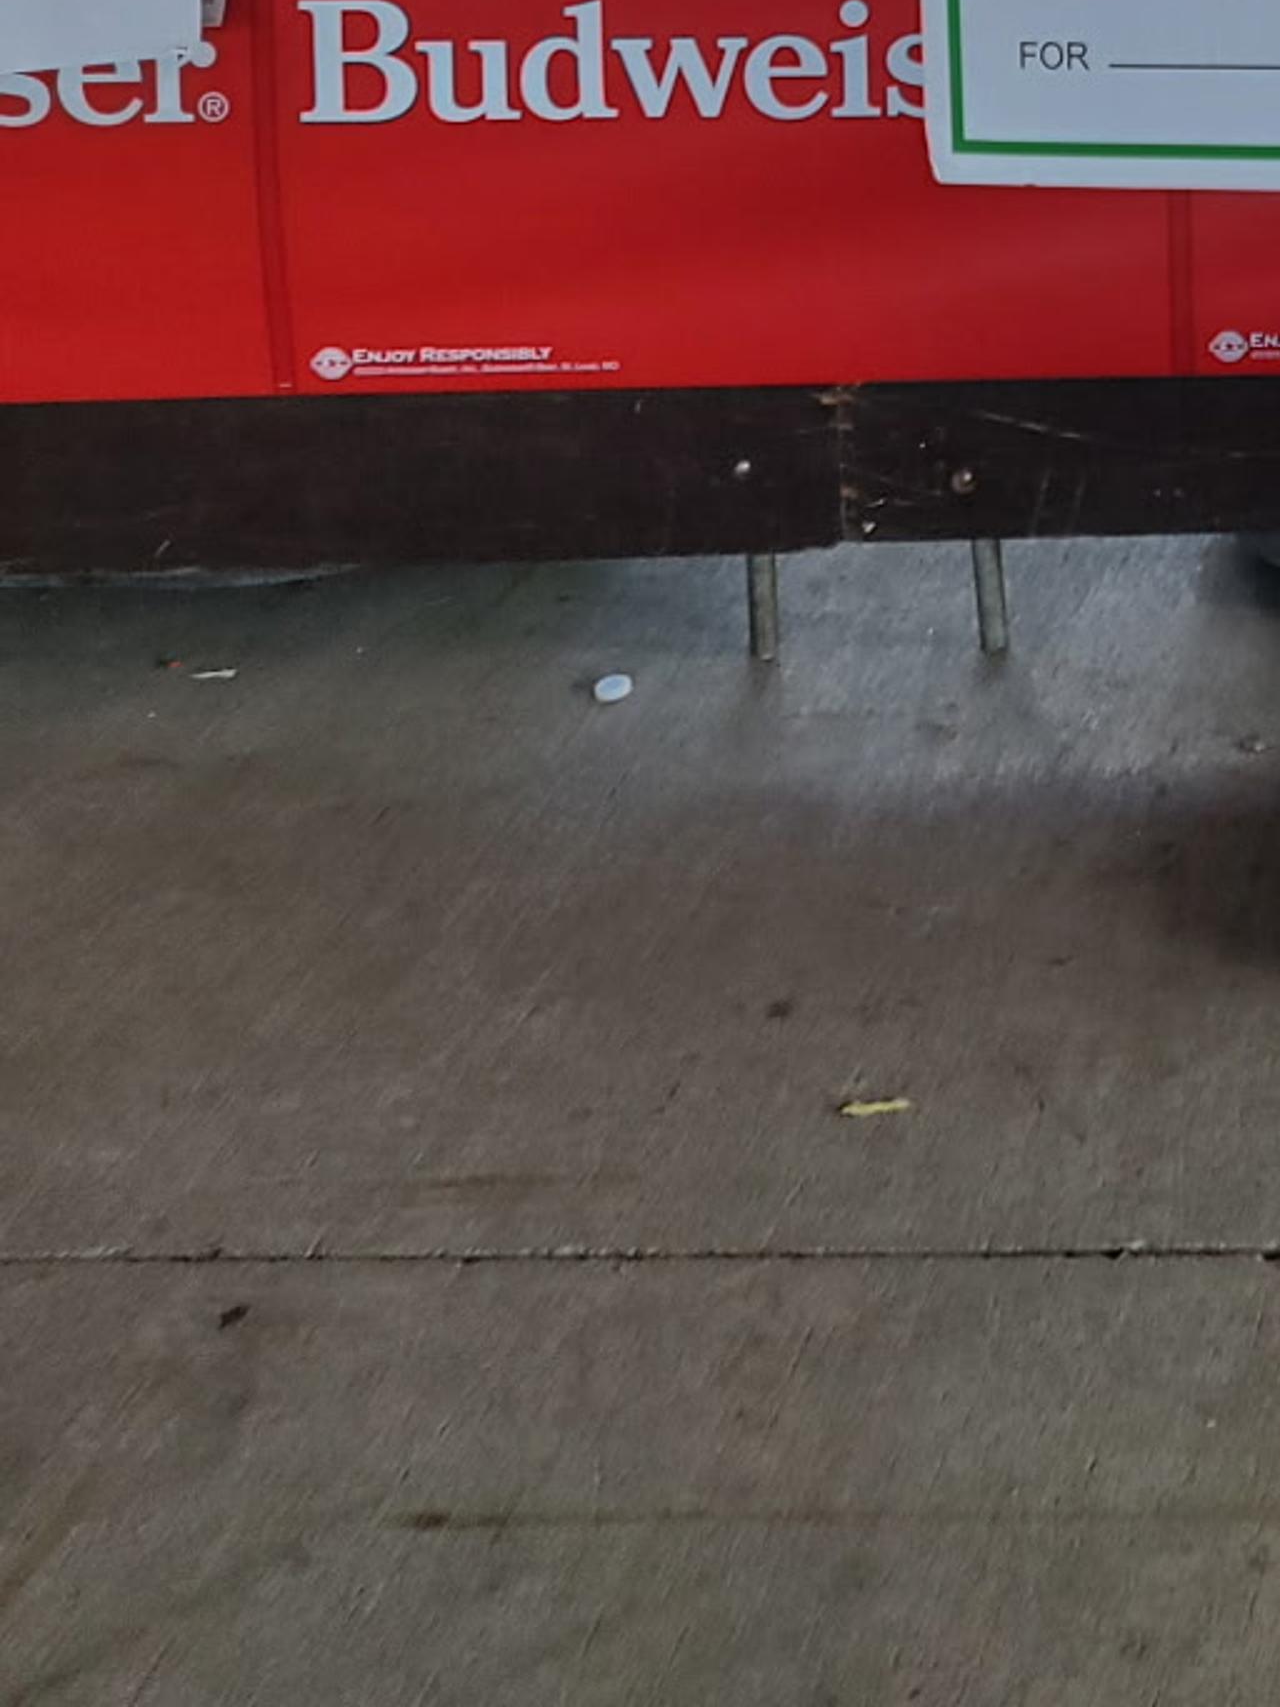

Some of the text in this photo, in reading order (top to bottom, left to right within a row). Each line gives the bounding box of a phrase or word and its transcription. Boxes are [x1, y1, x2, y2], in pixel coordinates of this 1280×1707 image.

[1018, 40, 1090, 73] FOR
[351, 346, 553, 364] ENJOY RESPONSIBLY
